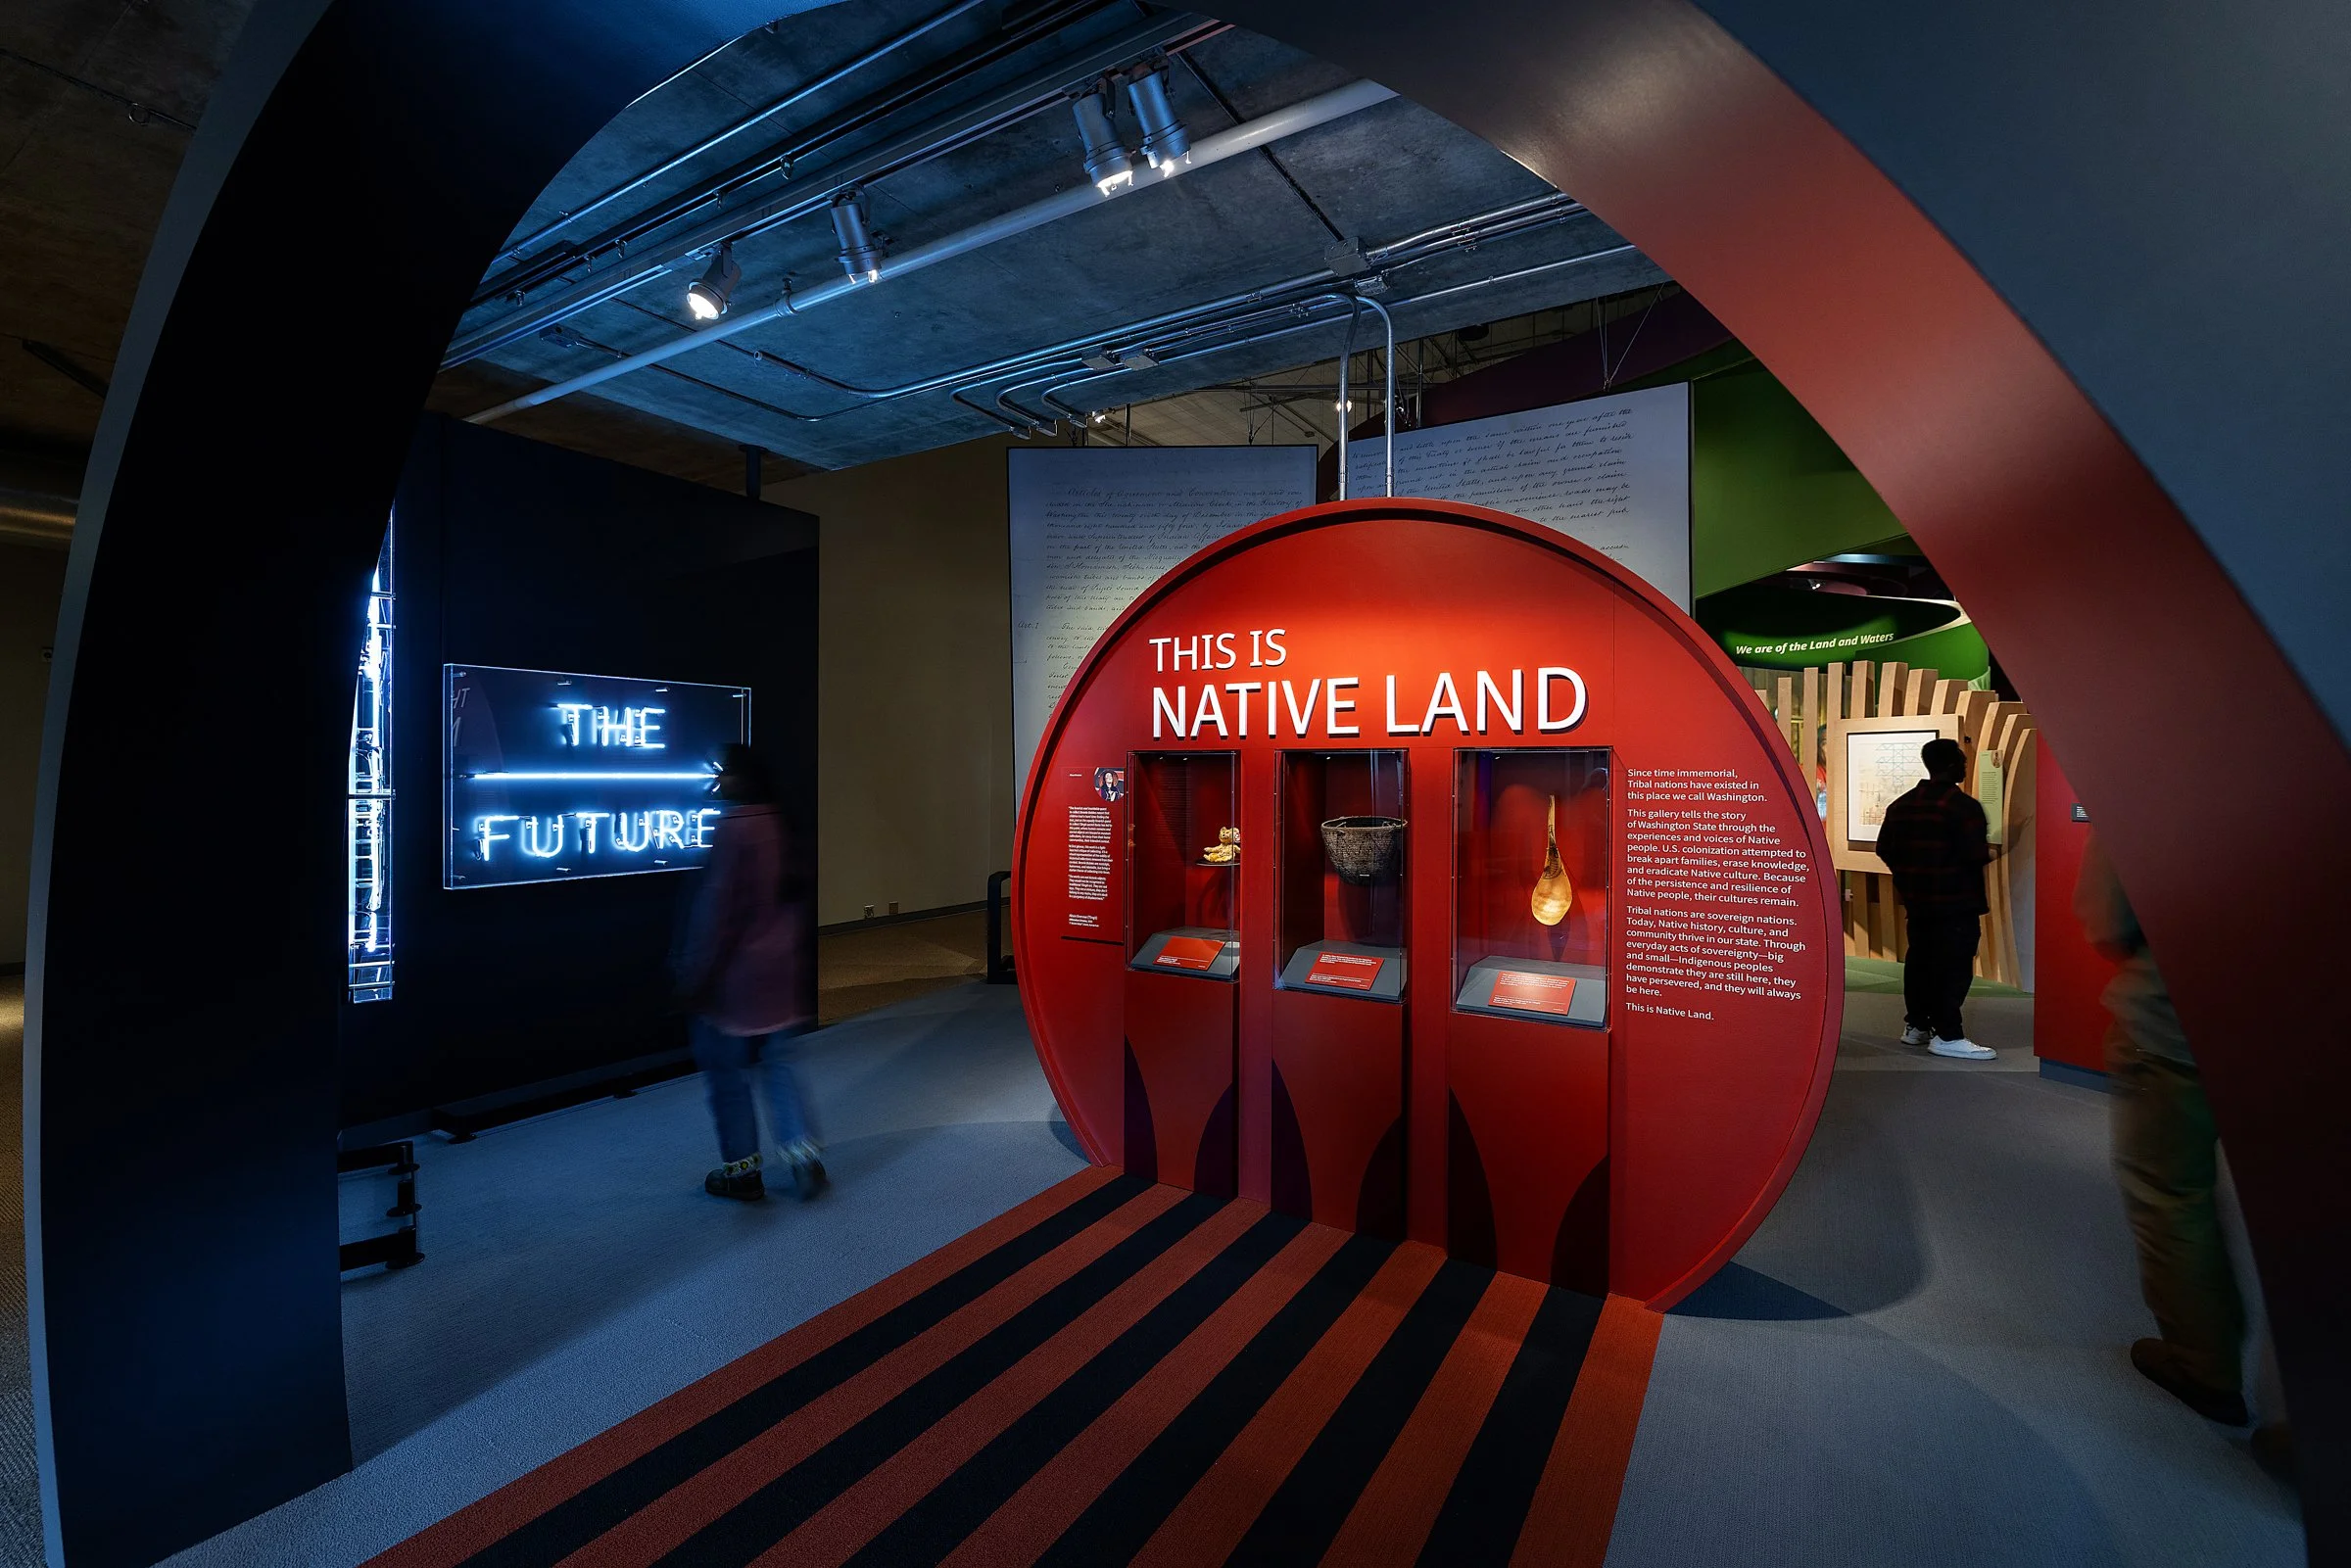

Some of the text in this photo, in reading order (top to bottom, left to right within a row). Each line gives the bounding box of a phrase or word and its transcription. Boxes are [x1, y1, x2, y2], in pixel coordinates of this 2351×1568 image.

[1149, 628, 1287, 673] THIS IS
[1736, 646, 1752, 654] We
[1775, 642, 1788, 655] of
[1789, 642, 1807, 652] the
[1809, 638, 1836, 650] Land
[1838, 636, 1858, 647] and
[1860, 632, 1894, 644] Waters
[1152, 666, 1588, 739] NATIVE LAND
[557, 703, 666, 749] THE
[1628, 768, 1738, 778] Since time immemorial,
[1628, 779, 1759, 789] Tribal nations have existed in
[1628, 791, 1644, 800] this
[1646, 791, 1670, 803] place
[1688, 791, 1704, 800] call
[1707, 791, 1767, 803] Washington.
[1628, 808, 1746, 822] This gallery tells the story
[483, 808, 721, 861] FUTURE
[1627, 820, 1775, 834] of Washington State through the
[1627, 832, 1780, 844] experiences and voices of Native
[1628, 843, 1660, 855] people.
[1663, 844, 1680, 853] U.S.
[1682, 844, 1739, 855] colonization
[1742, 847, 1793, 859] attempted
[1628, 854, 1652, 864] break
[1655, 857, 1679, 867] apart
[1681, 856, 1720, 867] families,
[1751, 858, 1809, 872] knowledge,
[1627, 865, 1806, 882] and eradicate Native culture. Because
[1627, 876, 1791, 893] of the persistence and resilience of
[1627, 888, 1799, 906] Native people, their cultures remain.
[1627, 906, 1651, 915] Tribal
[1654, 908, 1688, 918] nations
[1707, 913, 1754, 924] sovereign
[1757, 915, 1797, 924] nations.
[1627, 917, 1788, 936] Today, Native history, culture, and
[1626, 941, 1668, 954] everyday
[1670, 944, 1688, 952] acts
[1690, 944, 1700, 953] of
[1627, 930, 1677, 943] community
[1678, 932, 1704, 942] thrive
[1707, 934, 1715, 943] in
[1735, 937, 1761, 946] state.
[1763, 938, 1805, 952] Through
[1626, 951, 1643, 960] and
[1734, 961, 1773, 973] peoples
[1626, 961, 1684, 975] demonstrate
[1686, 967, 1707, 980] they
[1726, 971, 1744, 981] still
[1746, 972, 1771, 985] here,
[1774, 975, 1796, 988] they
[1626, 984, 1662, 996] be here.
[1627, 973, 1801, 1001] have persevered, and they will always
[1626, 1002, 1714, 1019] This is Native Land.
